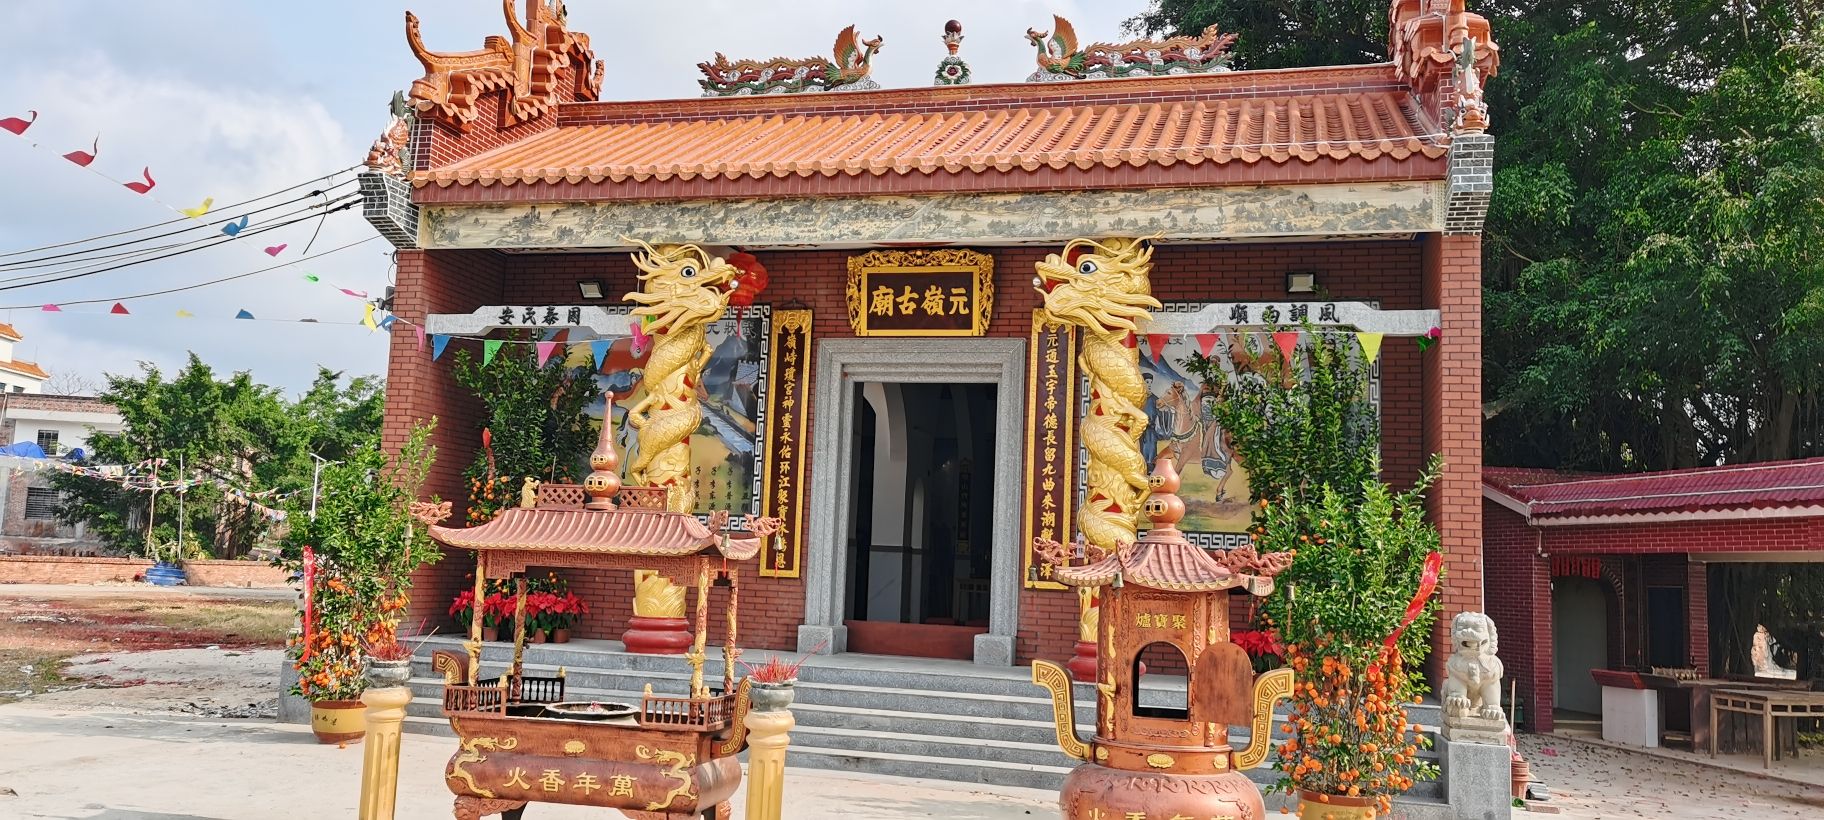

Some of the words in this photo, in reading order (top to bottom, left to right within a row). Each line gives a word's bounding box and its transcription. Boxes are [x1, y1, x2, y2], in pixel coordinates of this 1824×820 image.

[868, 285, 970, 317] 元嶺古廟
[1135, 612, 1187, 630] 聚寶爐
[502, 766, 639, 799] 萬年香火
